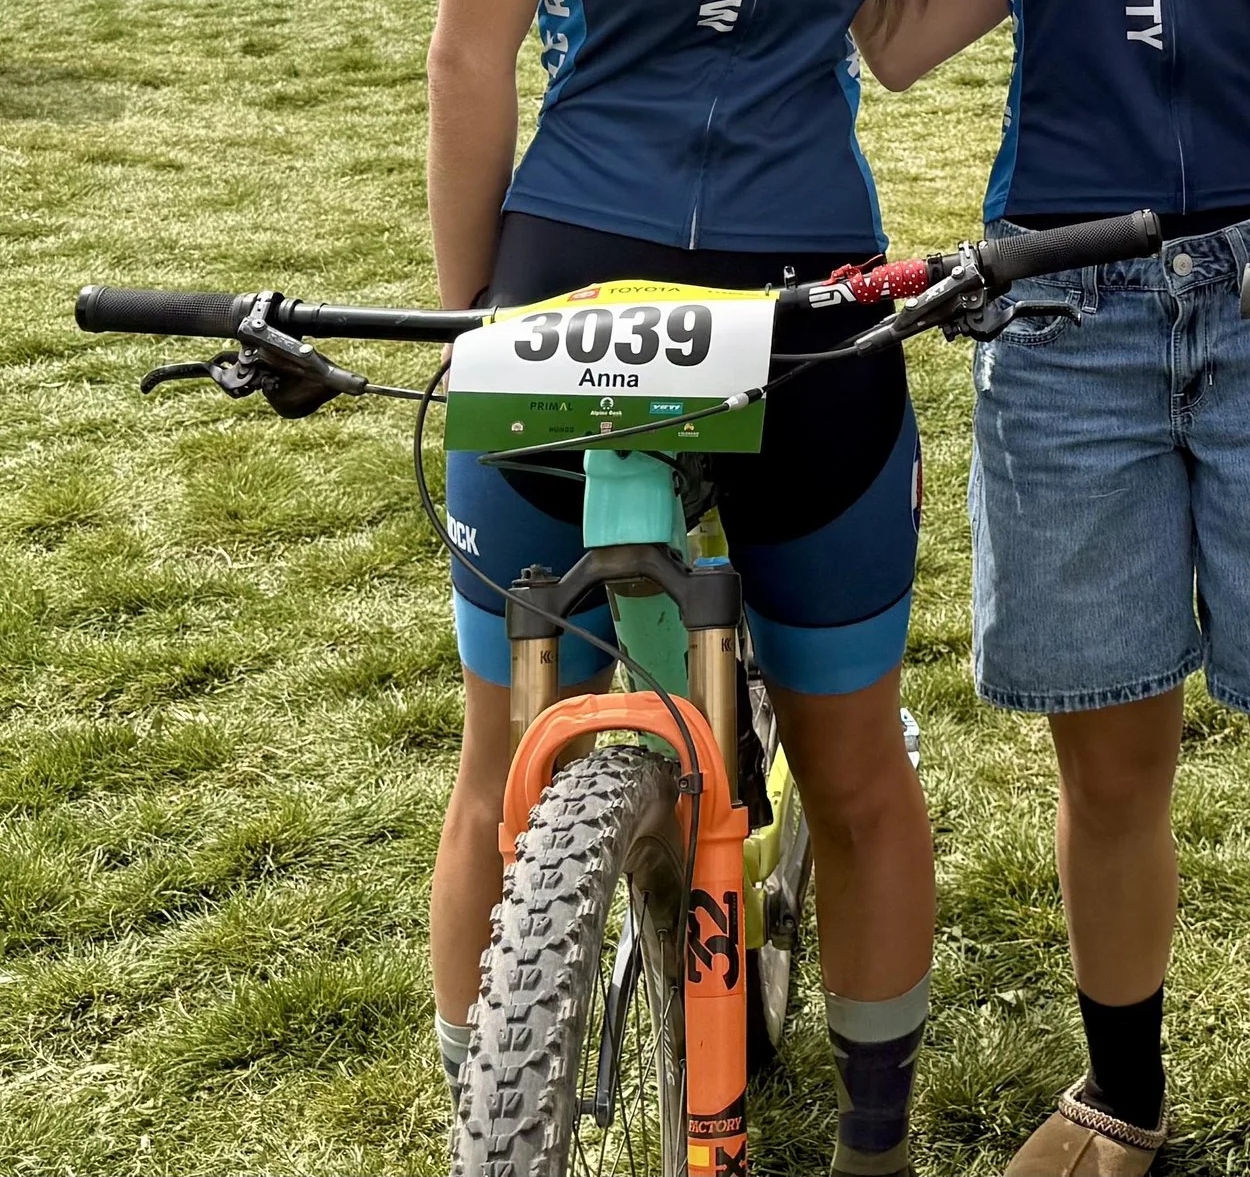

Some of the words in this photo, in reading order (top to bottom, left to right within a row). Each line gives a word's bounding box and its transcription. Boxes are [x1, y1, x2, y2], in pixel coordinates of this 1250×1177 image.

[608, 286, 681, 295] TOYOTA
[514, 304, 713, 367] 3039
[578, 368, 639, 388] Anna
[530, 401, 573, 411] PRIMAL
[446, 510, 480, 556] OCK
[687, 888, 740, 991] 32
